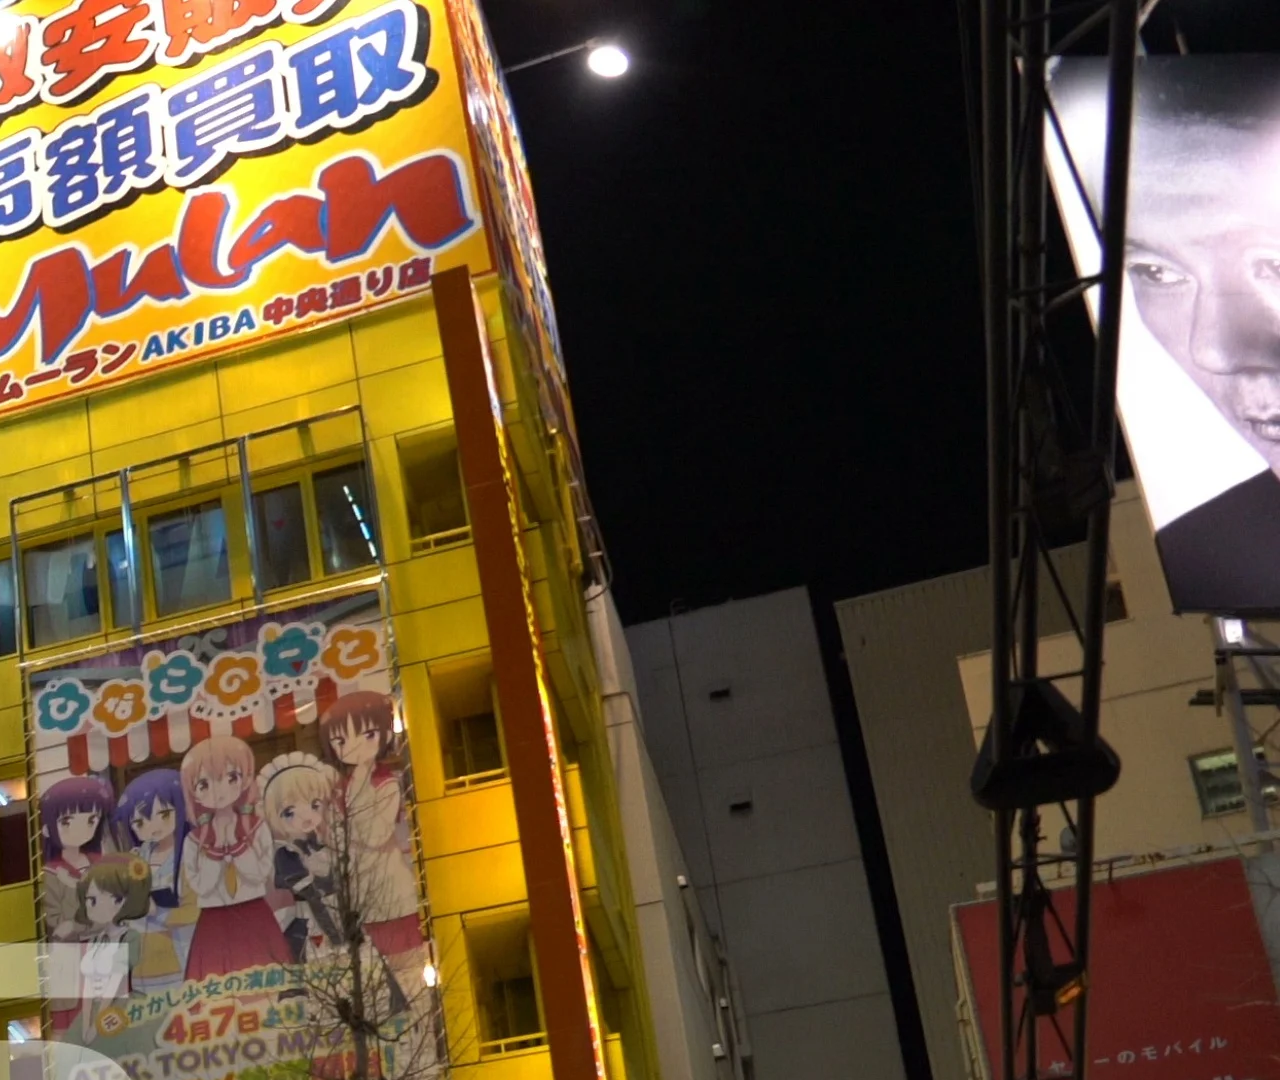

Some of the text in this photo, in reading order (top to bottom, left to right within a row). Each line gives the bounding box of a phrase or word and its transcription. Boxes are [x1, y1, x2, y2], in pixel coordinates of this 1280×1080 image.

[158, 1039, 267, 1077] TOKYO
[1049, 1035, 1228, 1073] ヤーのモバイル
